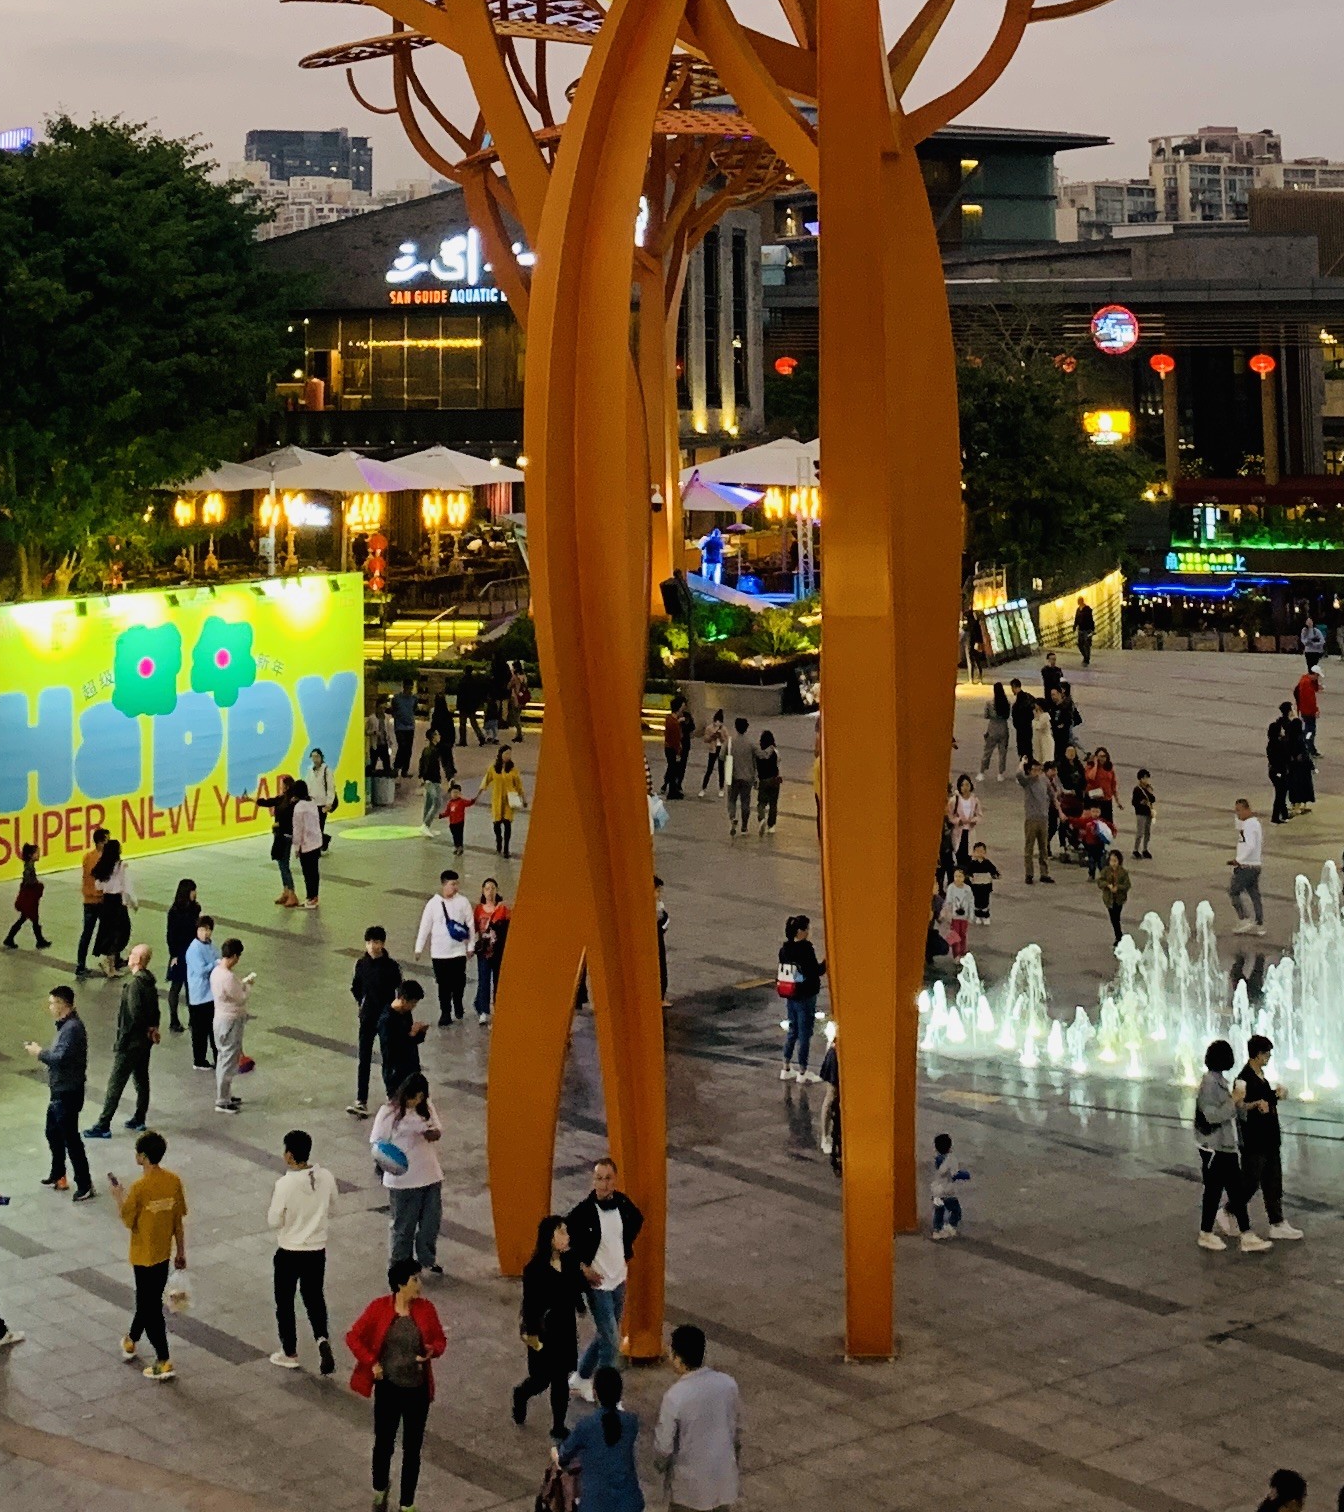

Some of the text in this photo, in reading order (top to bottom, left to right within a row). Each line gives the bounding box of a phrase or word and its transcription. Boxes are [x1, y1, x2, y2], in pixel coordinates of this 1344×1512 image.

[389, 290, 411, 304] SAN
[414, 289, 448, 304] GUIDE
[449, 287, 499, 304] AQUATIC
[257, 652, 285, 677] 新年
[121, 787, 201, 843] NEW
